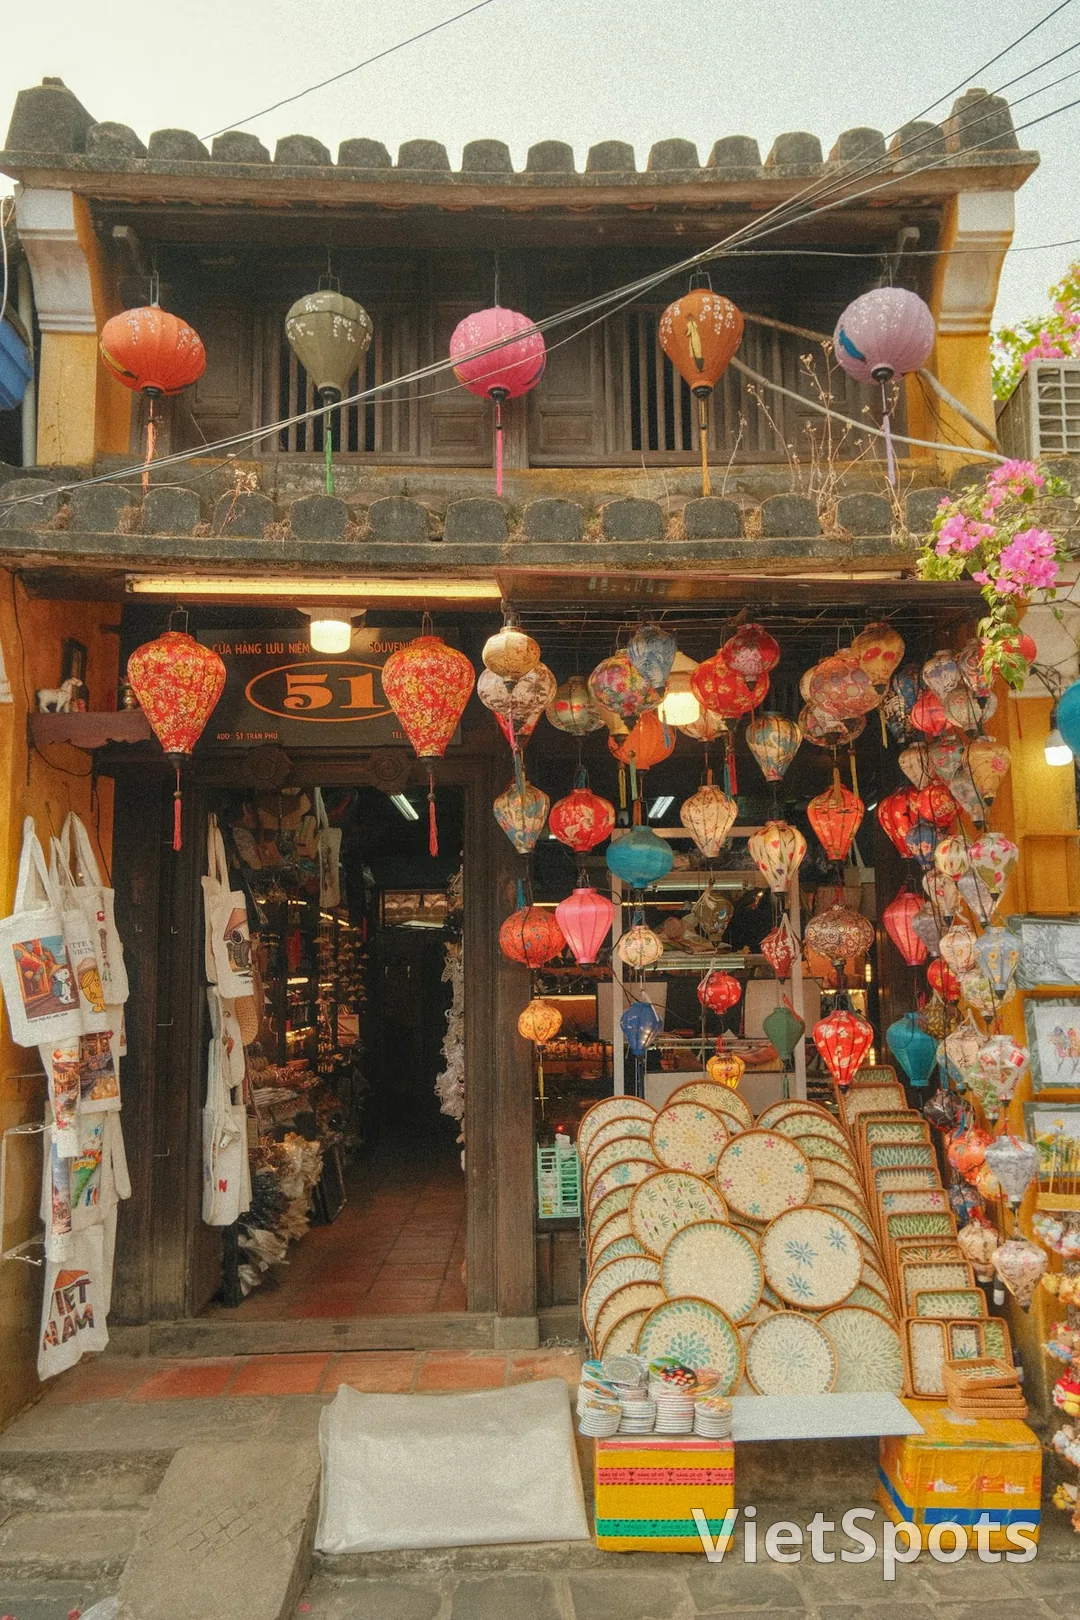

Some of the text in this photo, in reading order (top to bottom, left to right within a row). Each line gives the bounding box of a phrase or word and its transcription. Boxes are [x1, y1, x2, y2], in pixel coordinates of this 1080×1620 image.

[235, 641, 262, 655] HÀNG
[288, 640, 310, 655] NIỆM
[283, 672, 385, 710] 51
[235, 731, 244, 740] 51
[43, 1303, 94, 1351] NAM
